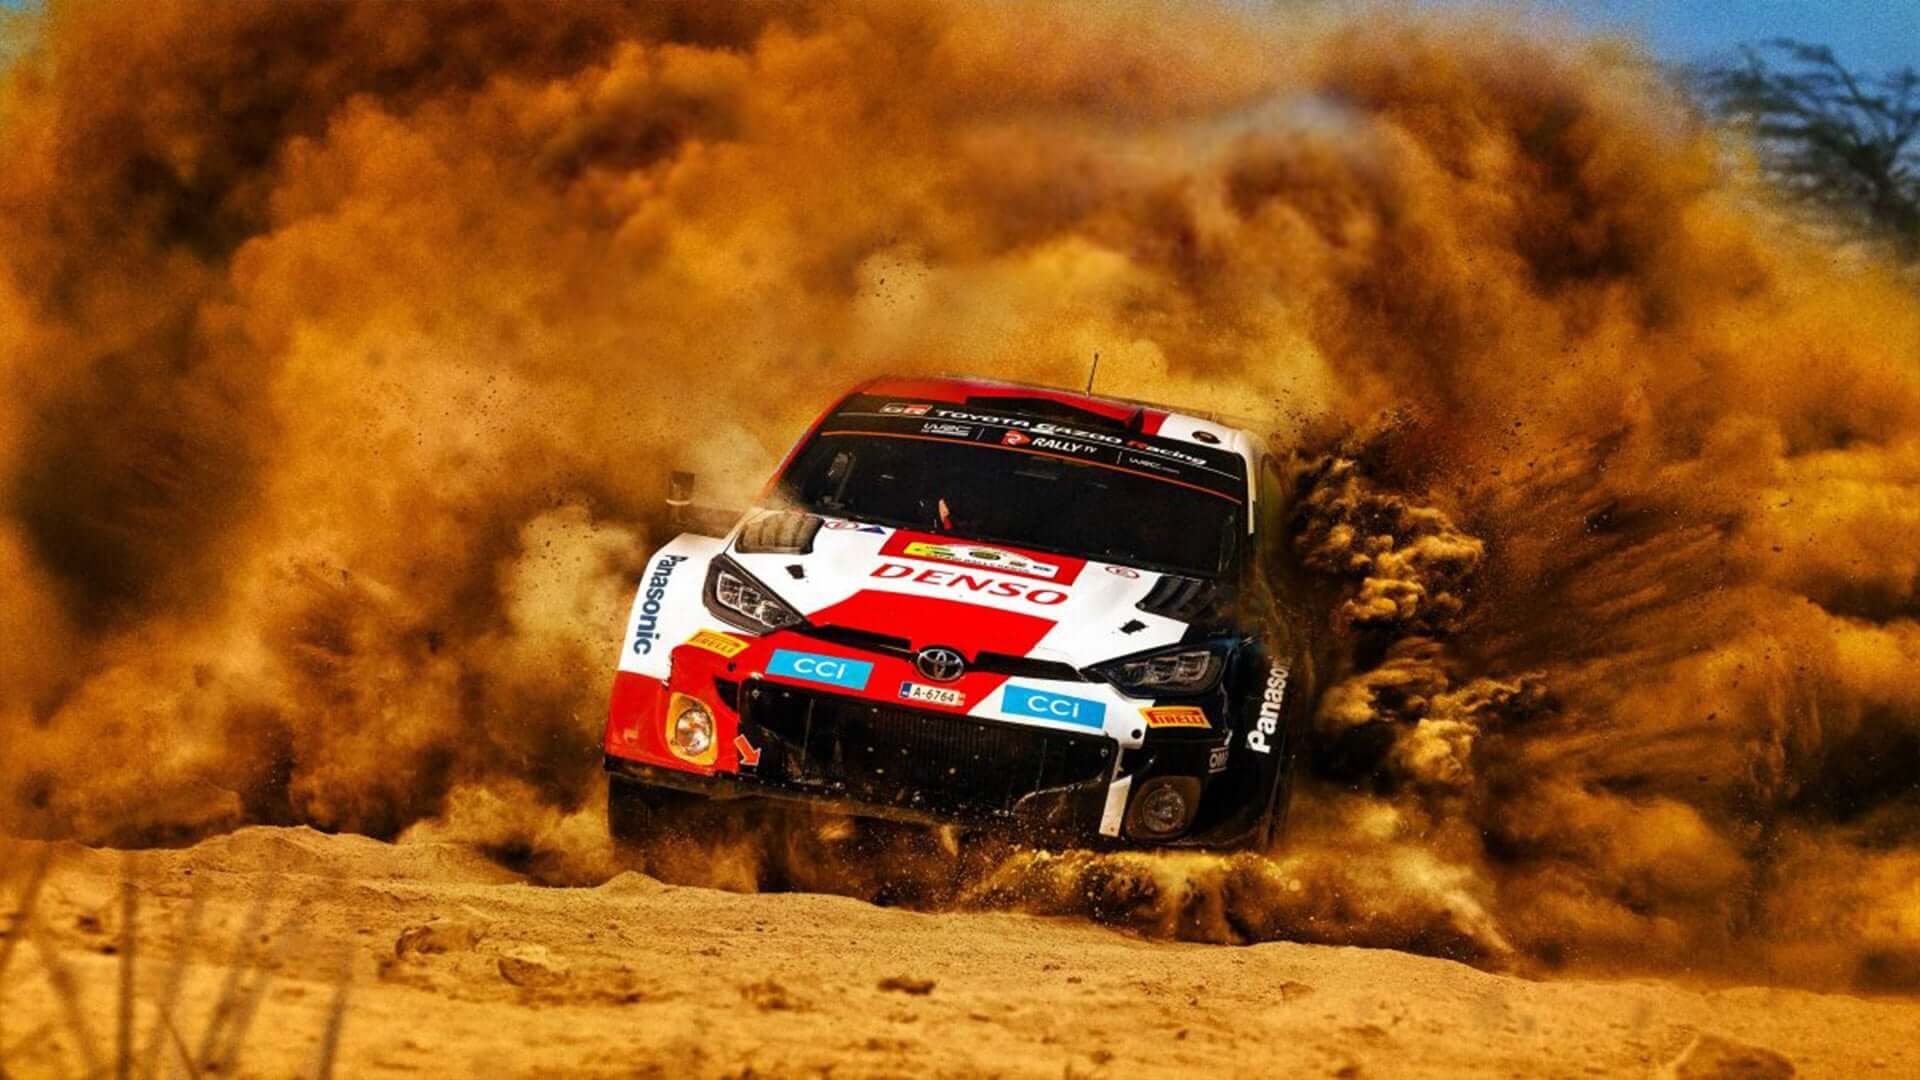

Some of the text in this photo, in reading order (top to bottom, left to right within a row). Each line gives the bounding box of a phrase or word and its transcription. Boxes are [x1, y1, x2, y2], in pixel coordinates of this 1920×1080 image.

[936, 409, 1030, 427] TOYOTA
[1034, 423, 1123, 444] GAZOO
[1126, 440, 1207, 465] Racing
[1032, 436, 1082, 453] RALLY
[633, 554, 688, 655] Panasonic
[869, 563, 1069, 605] DENSO
[913, 687, 955, 702] A-6764
[1247, 656, 1292, 754] Panason
[1146, 710, 1205, 724] PIRELLI
